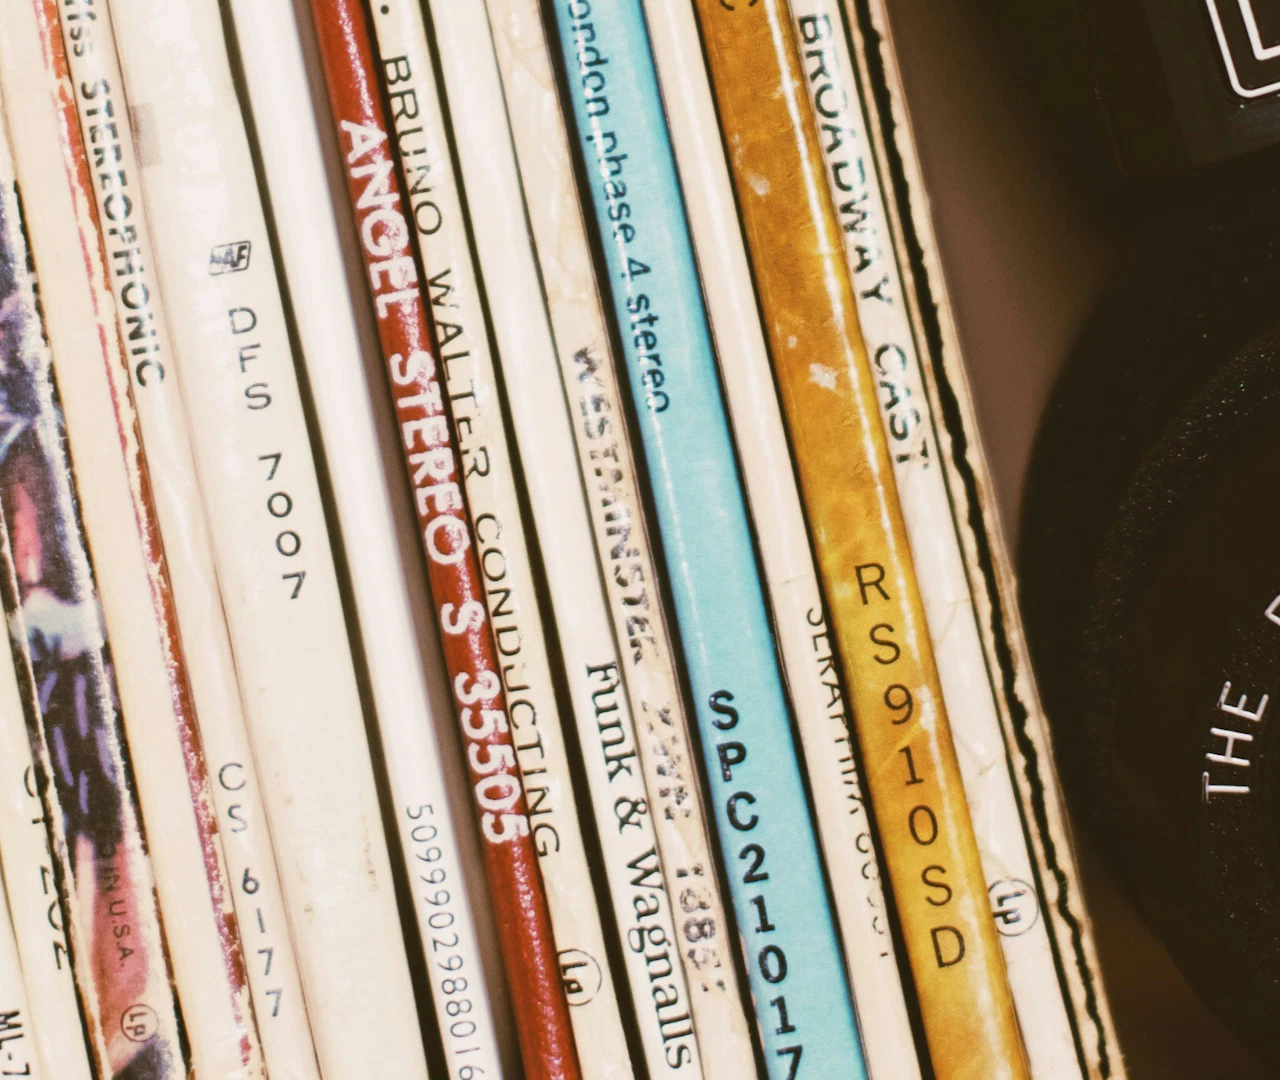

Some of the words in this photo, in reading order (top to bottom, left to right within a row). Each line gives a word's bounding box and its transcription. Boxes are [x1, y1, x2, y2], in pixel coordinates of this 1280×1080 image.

[79, 78, 166, 389] STEREOPHONIC
[338, 115, 420, 320] ANGEL
[586, 129, 644, 246] phase
[797, 11, 892, 311] BROADWAY
[871, 340, 931, 473] CAST
[619, 253, 652, 285] 4
[625, 292, 677, 415] stereo
[227, 304, 274, 414] DFS
[255, 451, 311, 603] 7007
[381, 55, 443, 239] BRUNO
[424, 268, 492, 481] WALTER
[468, 511, 564, 860] CONDUCTING
[387, 347, 473, 568] STEREO
[436, 596, 485, 638] S
[451, 666, 530, 848] 35505
[584, 659, 642, 783] Funk
[1201, 680, 1269, 805] THE
[611, 792, 651, 834] &
[106, 898, 136, 968] U.S.A.
[614, 843, 701, 1073] Wagnalls
